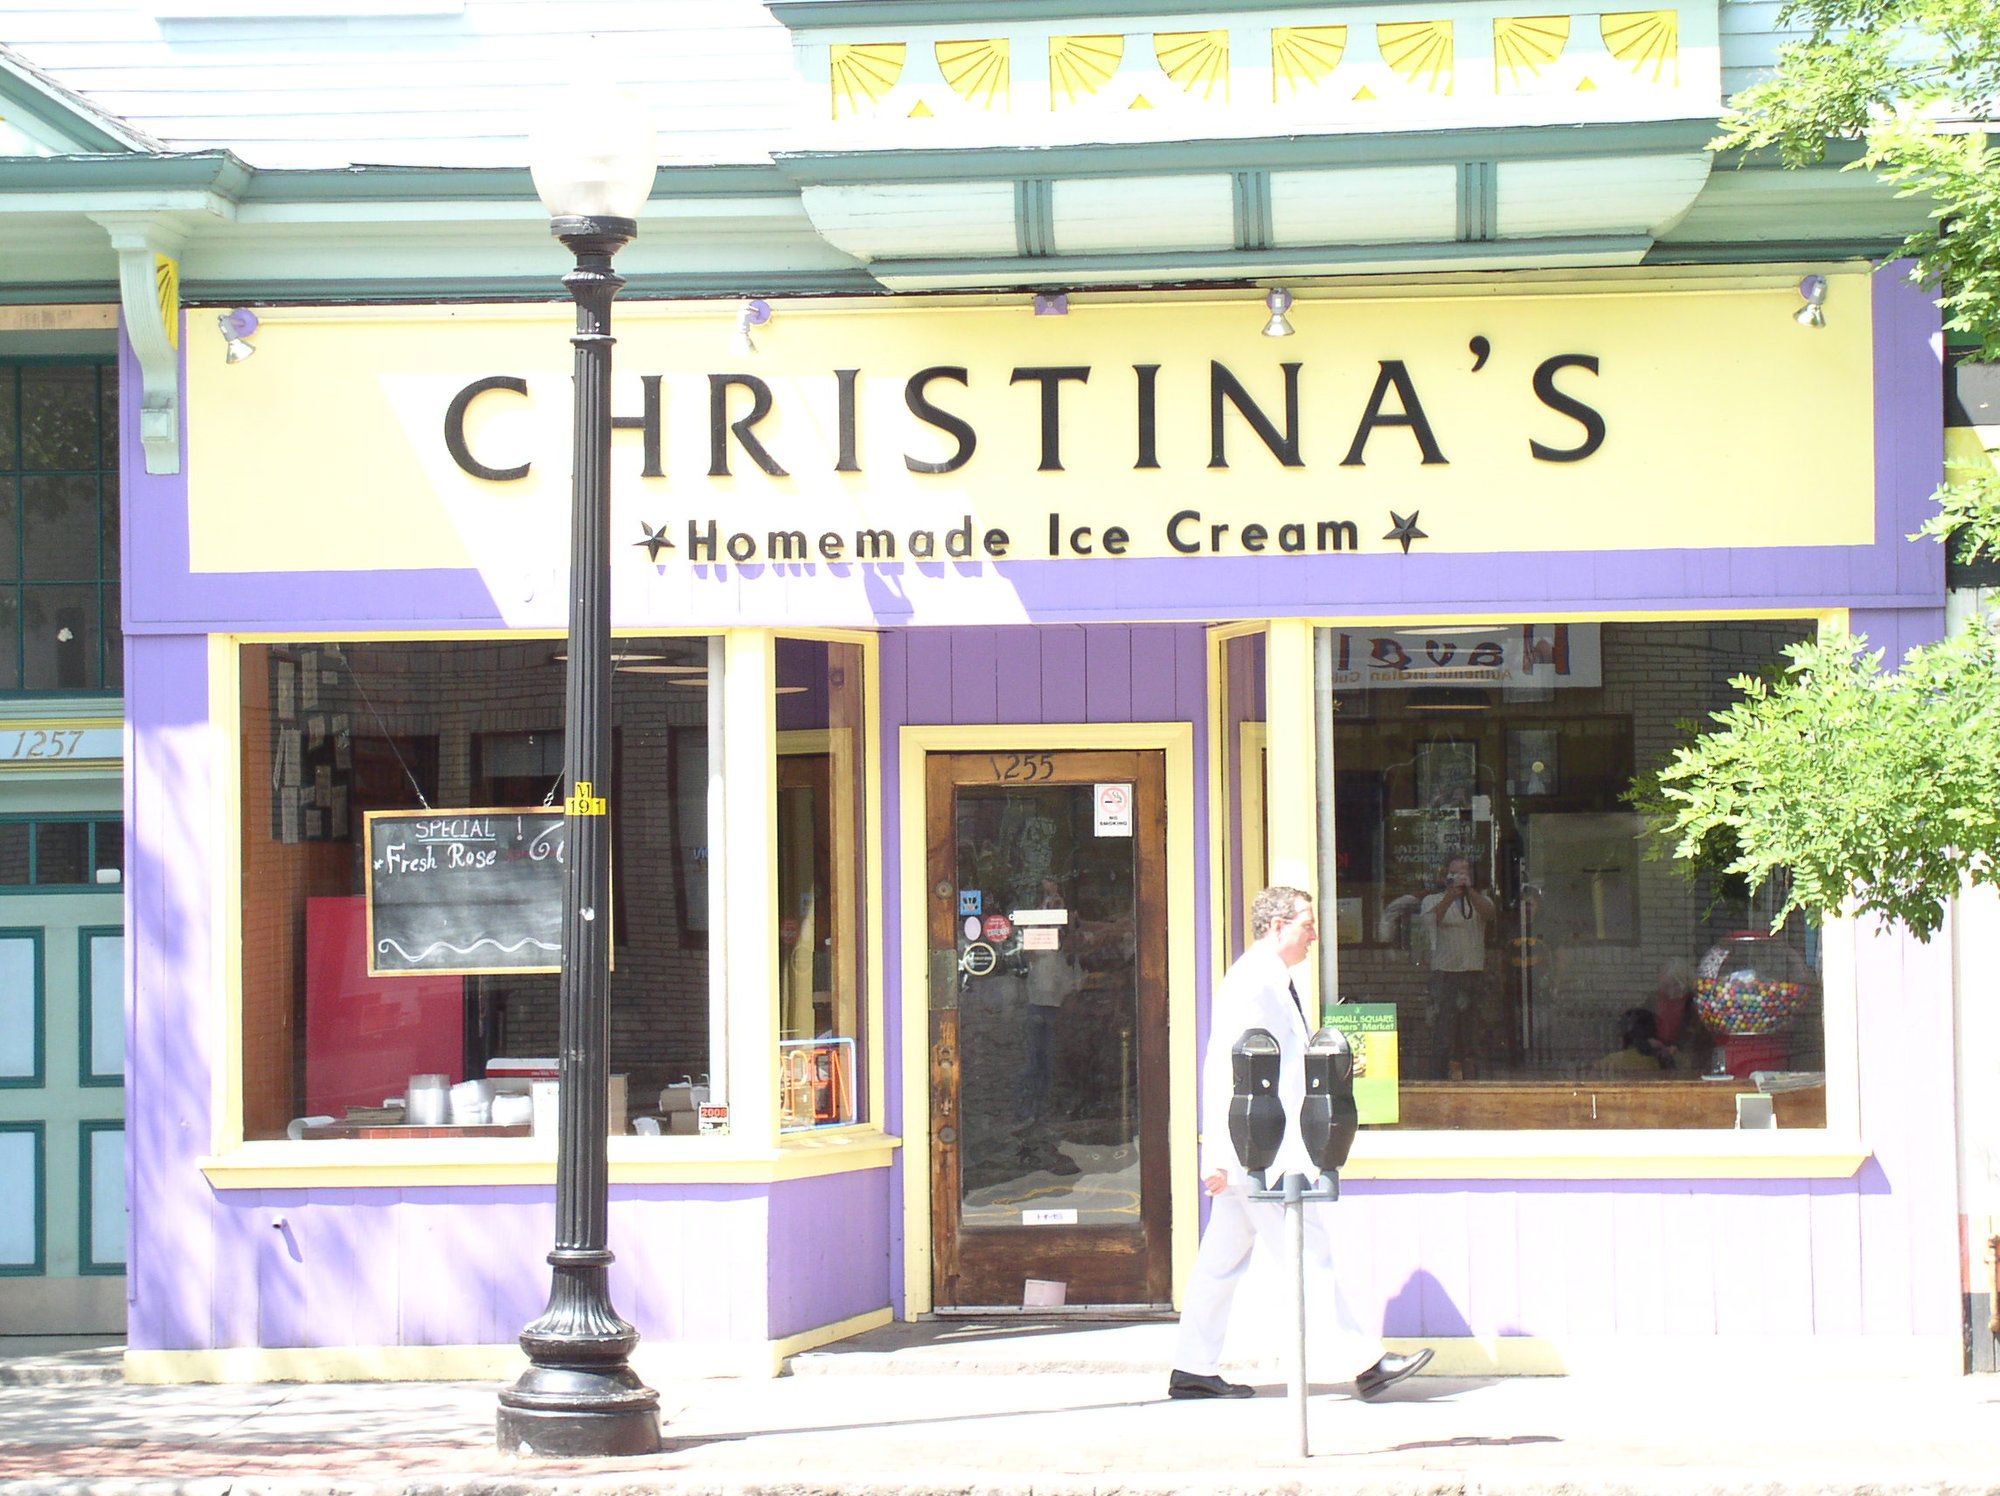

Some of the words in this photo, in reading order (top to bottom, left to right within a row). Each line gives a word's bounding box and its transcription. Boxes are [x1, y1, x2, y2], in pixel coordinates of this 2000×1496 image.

[444, 334, 1607, 482] CHRISTINA'S
[687, 514, 1010, 564] Homemade
[1048, 512, 1130, 557] Ice
[1166, 508, 1360, 556] Cream
[11, 730, 85, 759] 1257
[989, 752, 1054, 781] 1255
[570, 799, 601, 814] 191
[415, 819, 496, 838] SPECIAL
[385, 842, 438, 874] Fresh
[447, 842, 497, 869] Rose
[1362, 1022, 1394, 1031] Market
[700, 1107, 728, 1118] 2008
